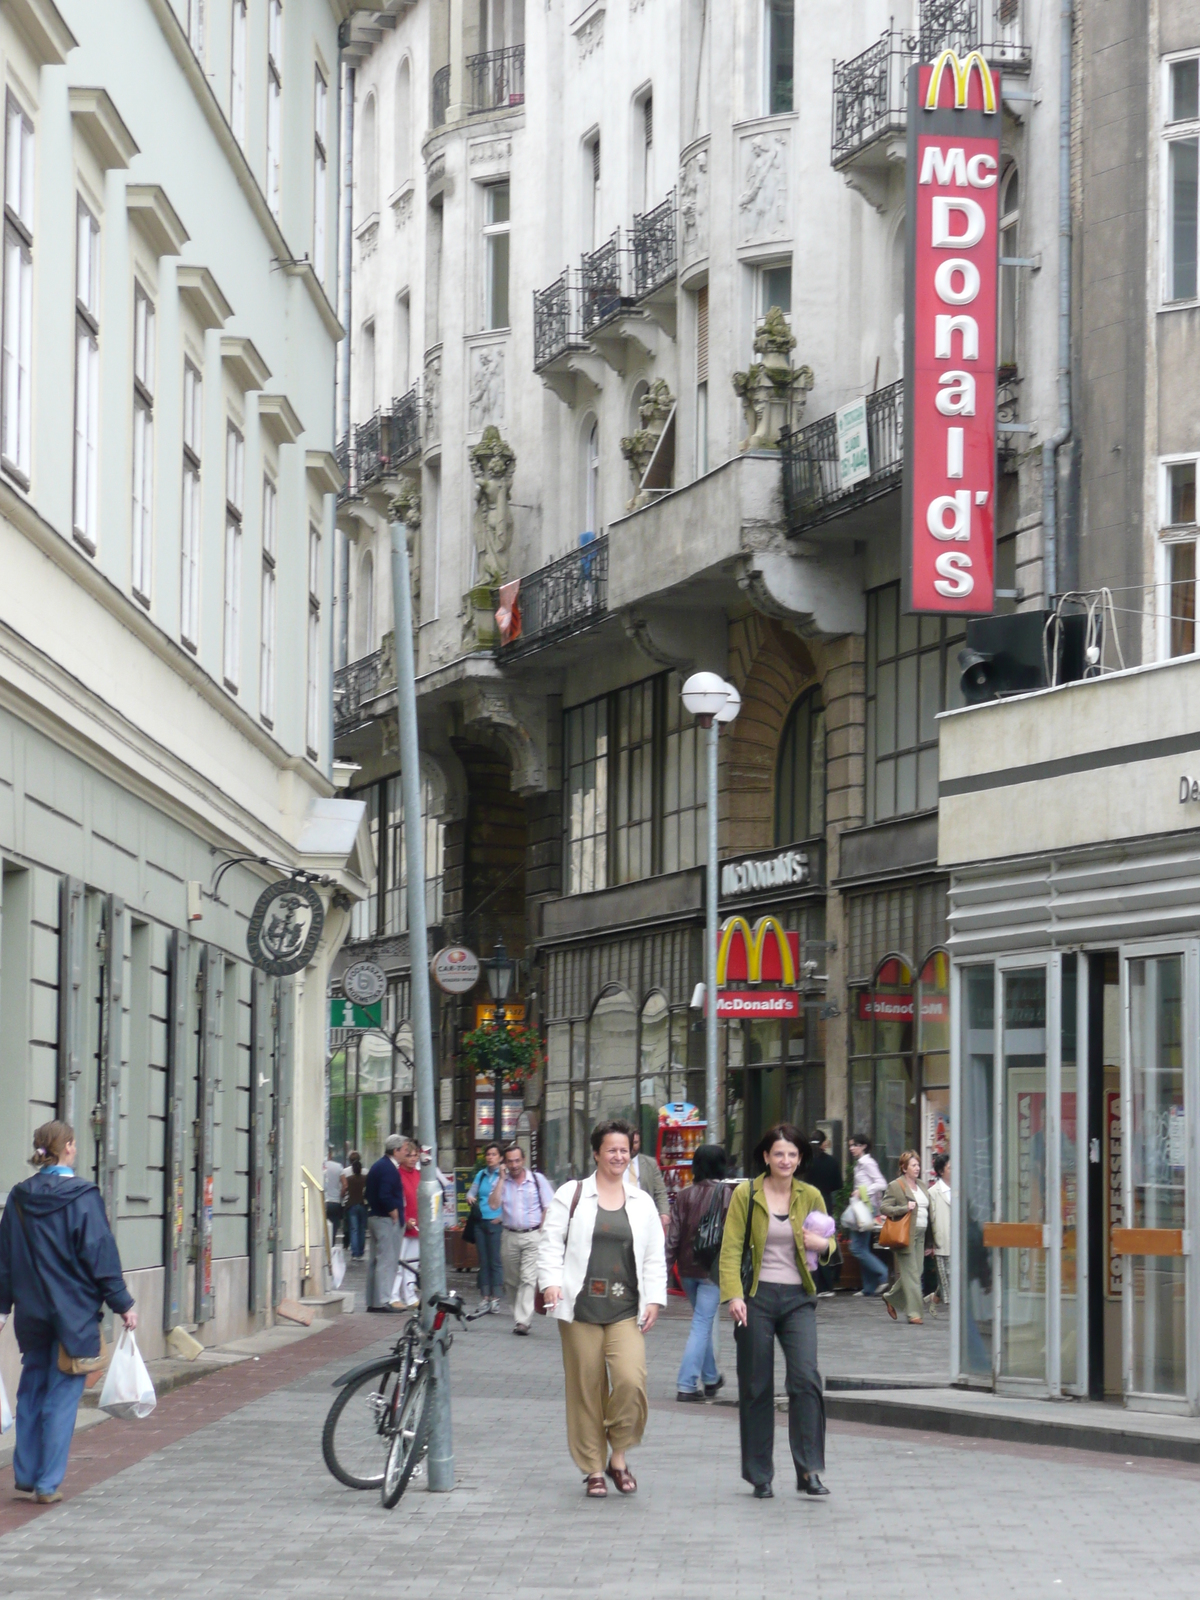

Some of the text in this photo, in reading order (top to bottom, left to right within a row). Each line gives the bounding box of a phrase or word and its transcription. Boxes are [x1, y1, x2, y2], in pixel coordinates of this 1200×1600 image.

[918, 145, 998, 600] McDonald's
[1179, 775, 1200, 804] De
[438, 964, 478, 972] CAR-TOUR
[716, 997, 794, 1011] McDonald's
